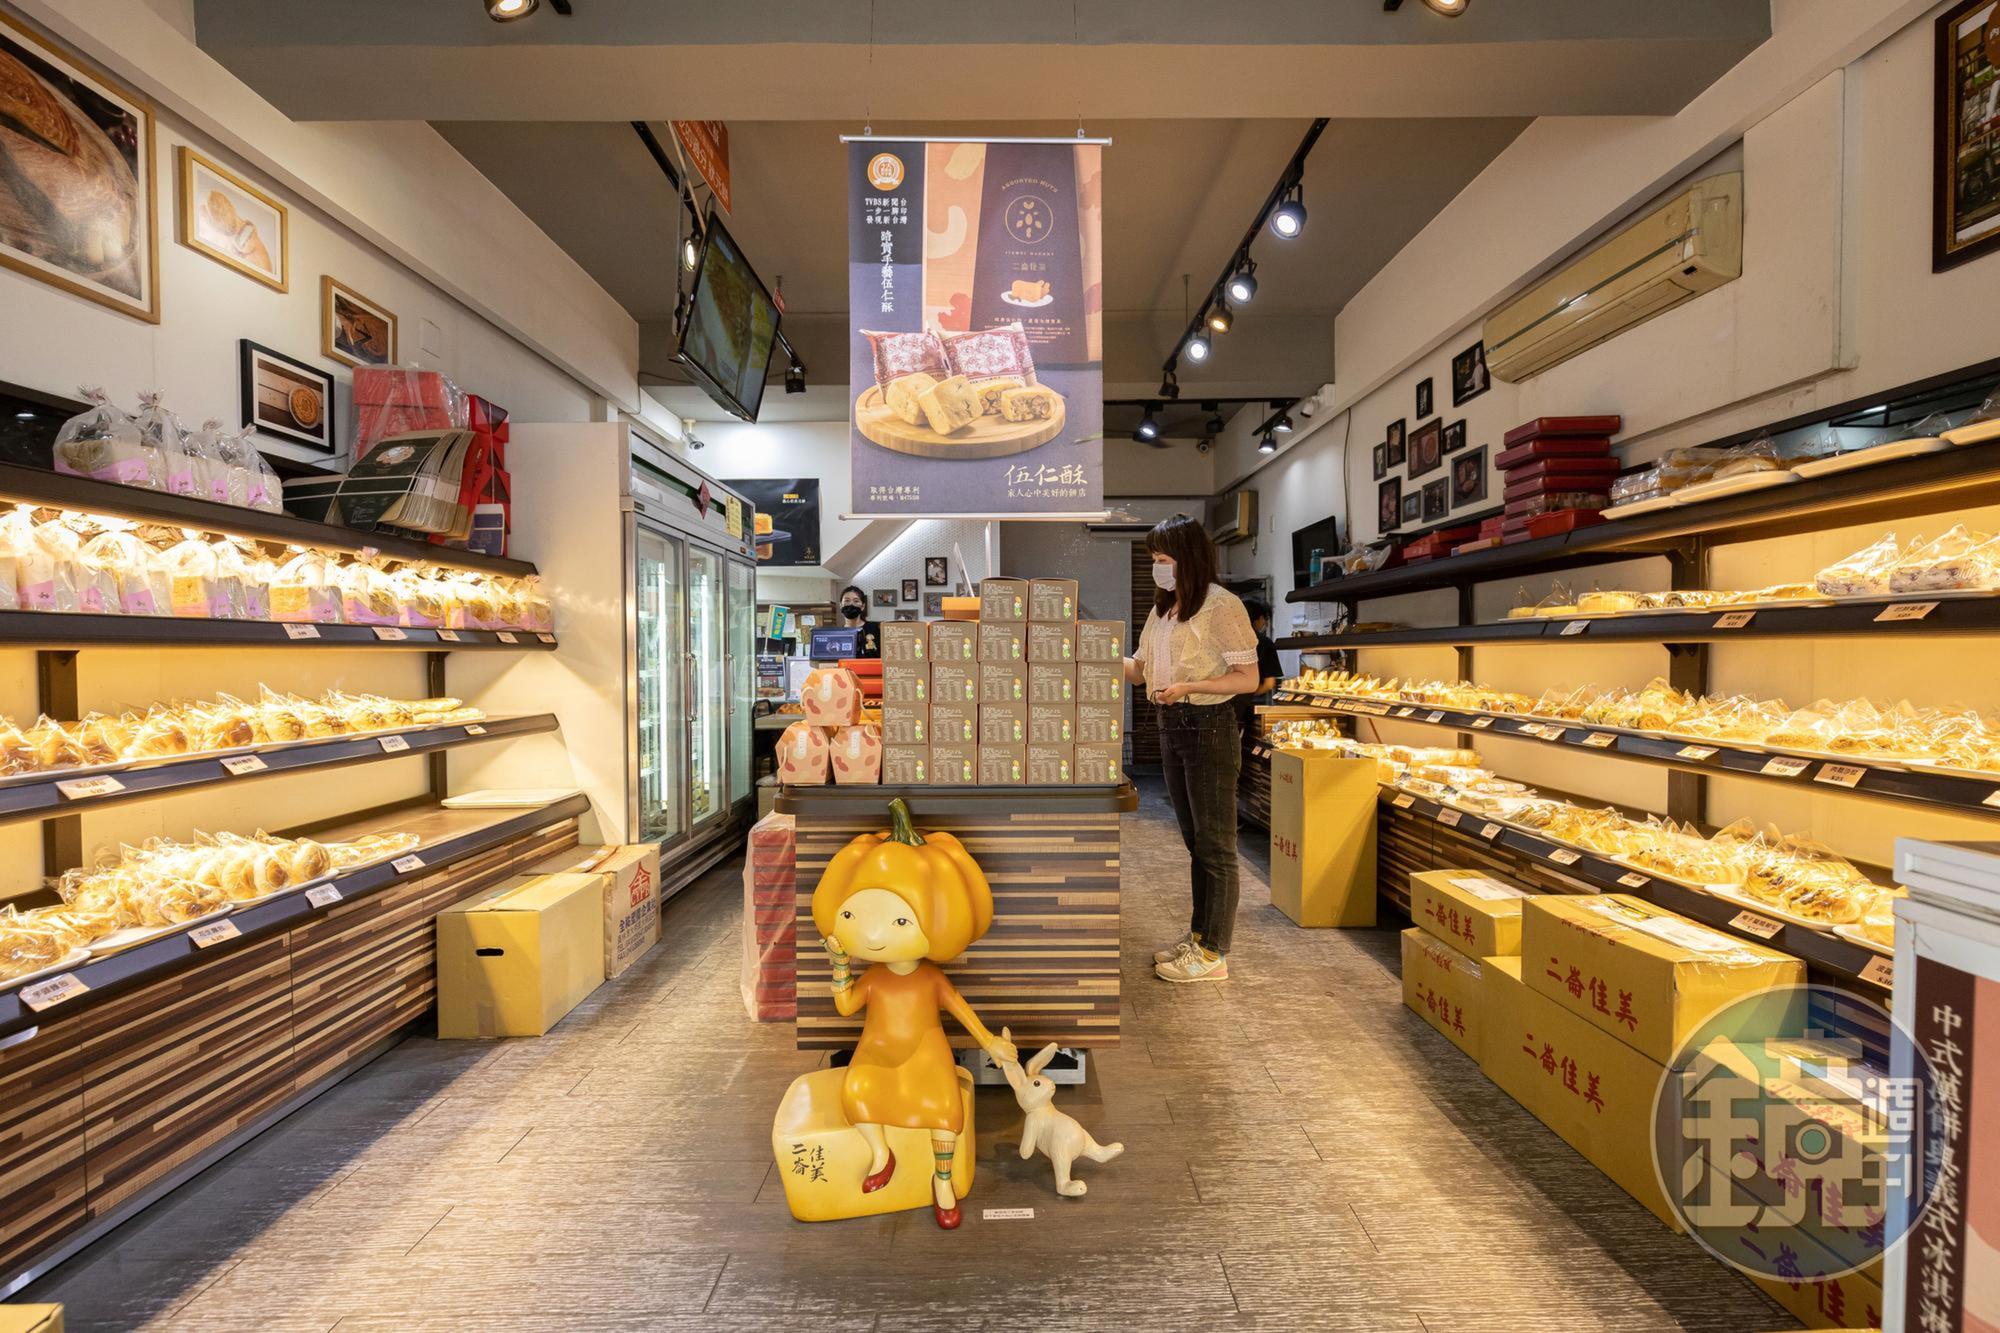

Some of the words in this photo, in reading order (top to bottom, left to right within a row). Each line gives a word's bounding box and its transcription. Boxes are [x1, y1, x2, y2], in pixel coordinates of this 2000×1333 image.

[1003, 464, 1088, 486] 伍仁酥
[1274, 834, 1298, 861] 二崙佳美
[1425, 898, 1476, 946] 二崙佳美
[1416, 982, 1466, 1037] 二崙佳美
[1546, 957, 1638, 1032] 二崙佳美
[1522, 1033, 1605, 1114] 二崙佳美
